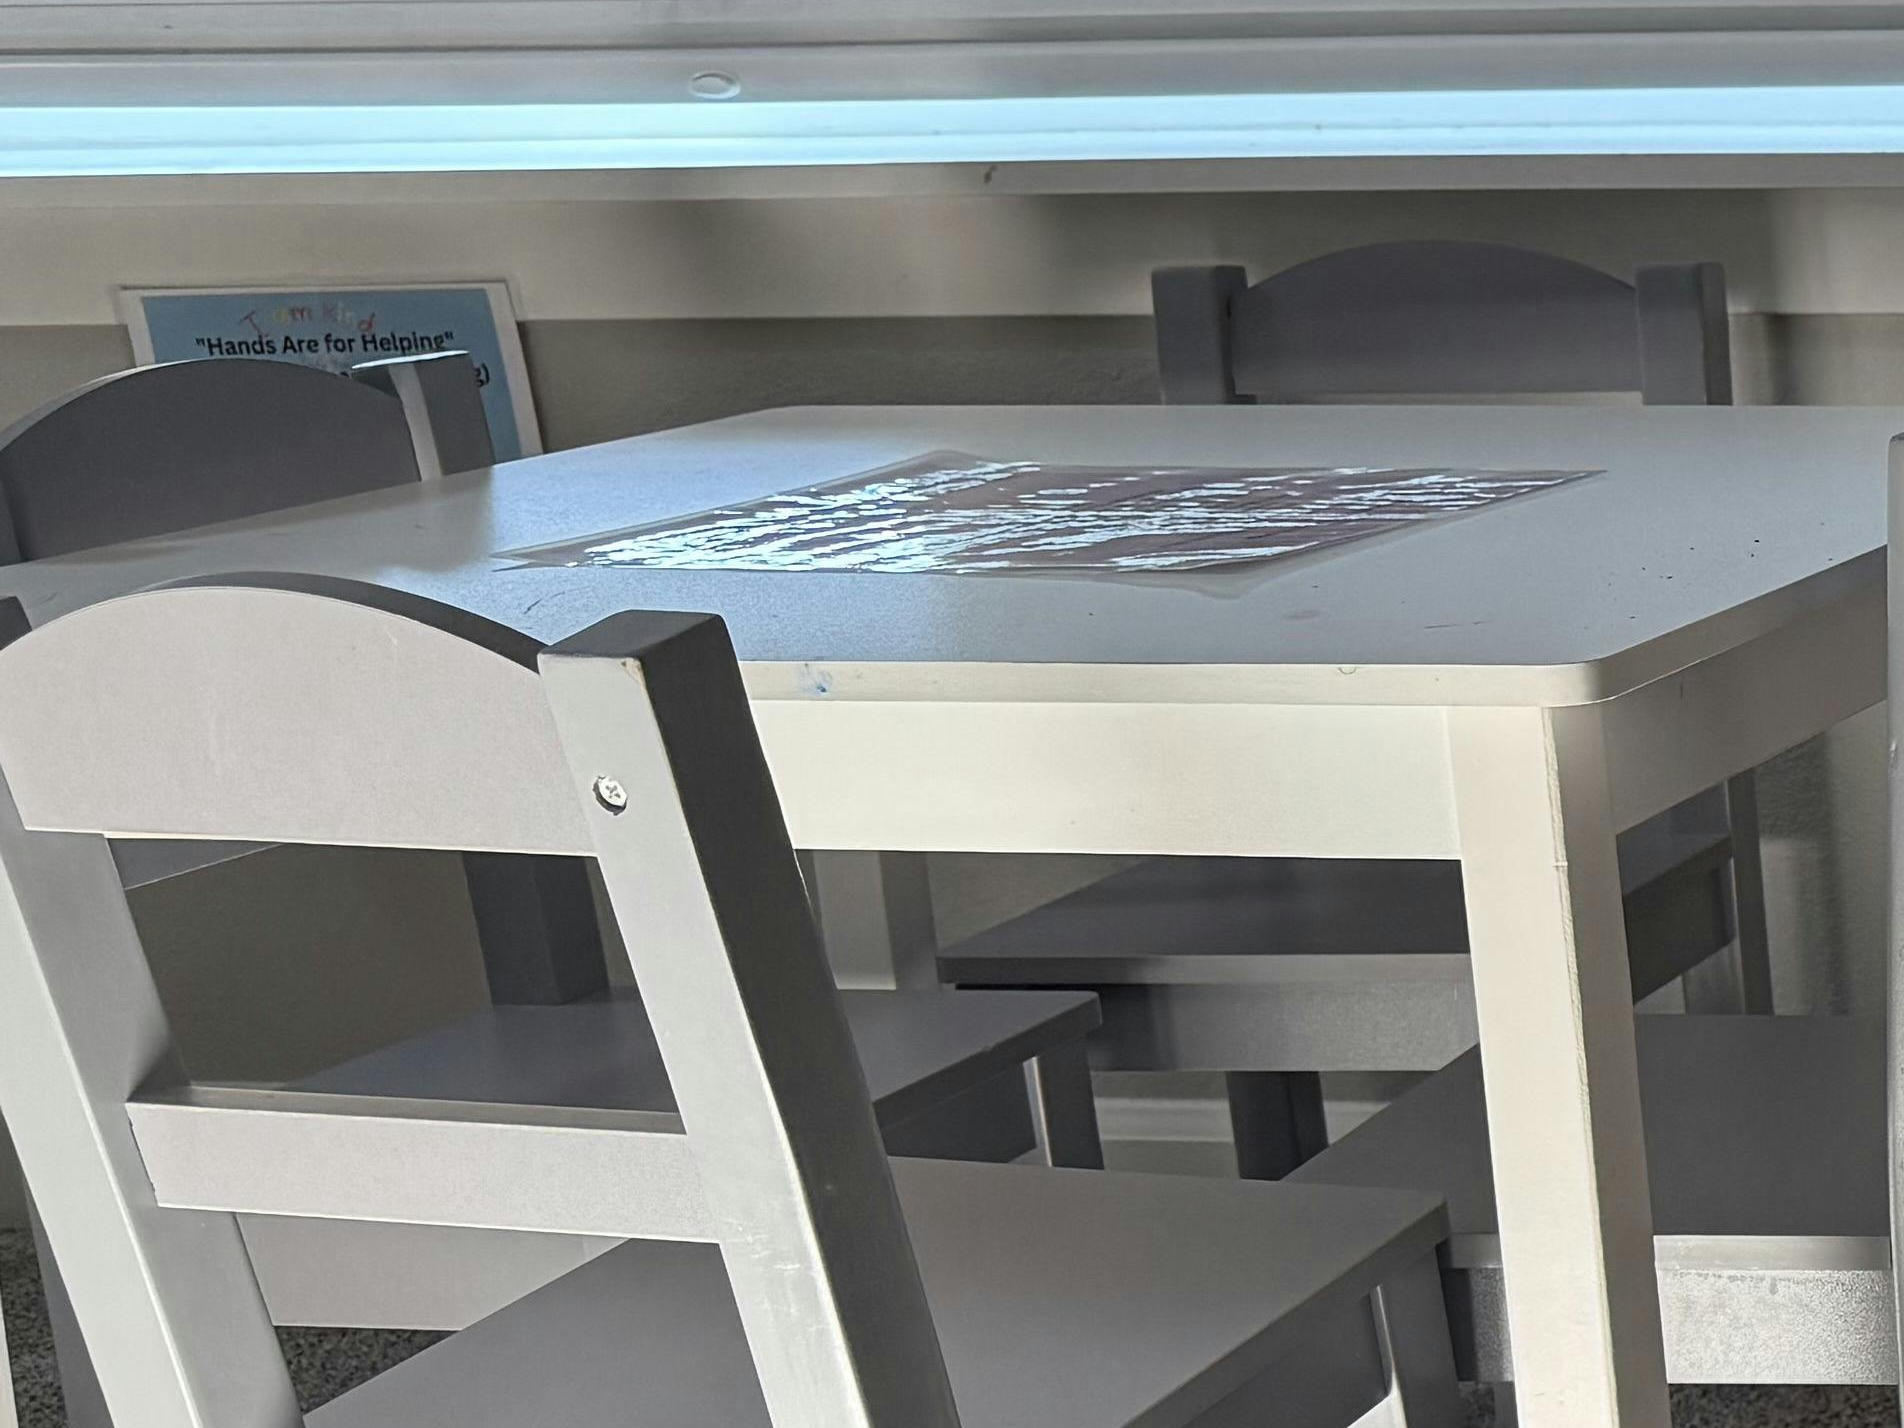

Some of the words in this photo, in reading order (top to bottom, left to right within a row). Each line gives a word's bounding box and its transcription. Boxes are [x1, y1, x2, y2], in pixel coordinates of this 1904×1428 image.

[195, 335, 276, 356] "Hands
[282, 335, 319, 353] Are
[325, 333, 356, 352] for
